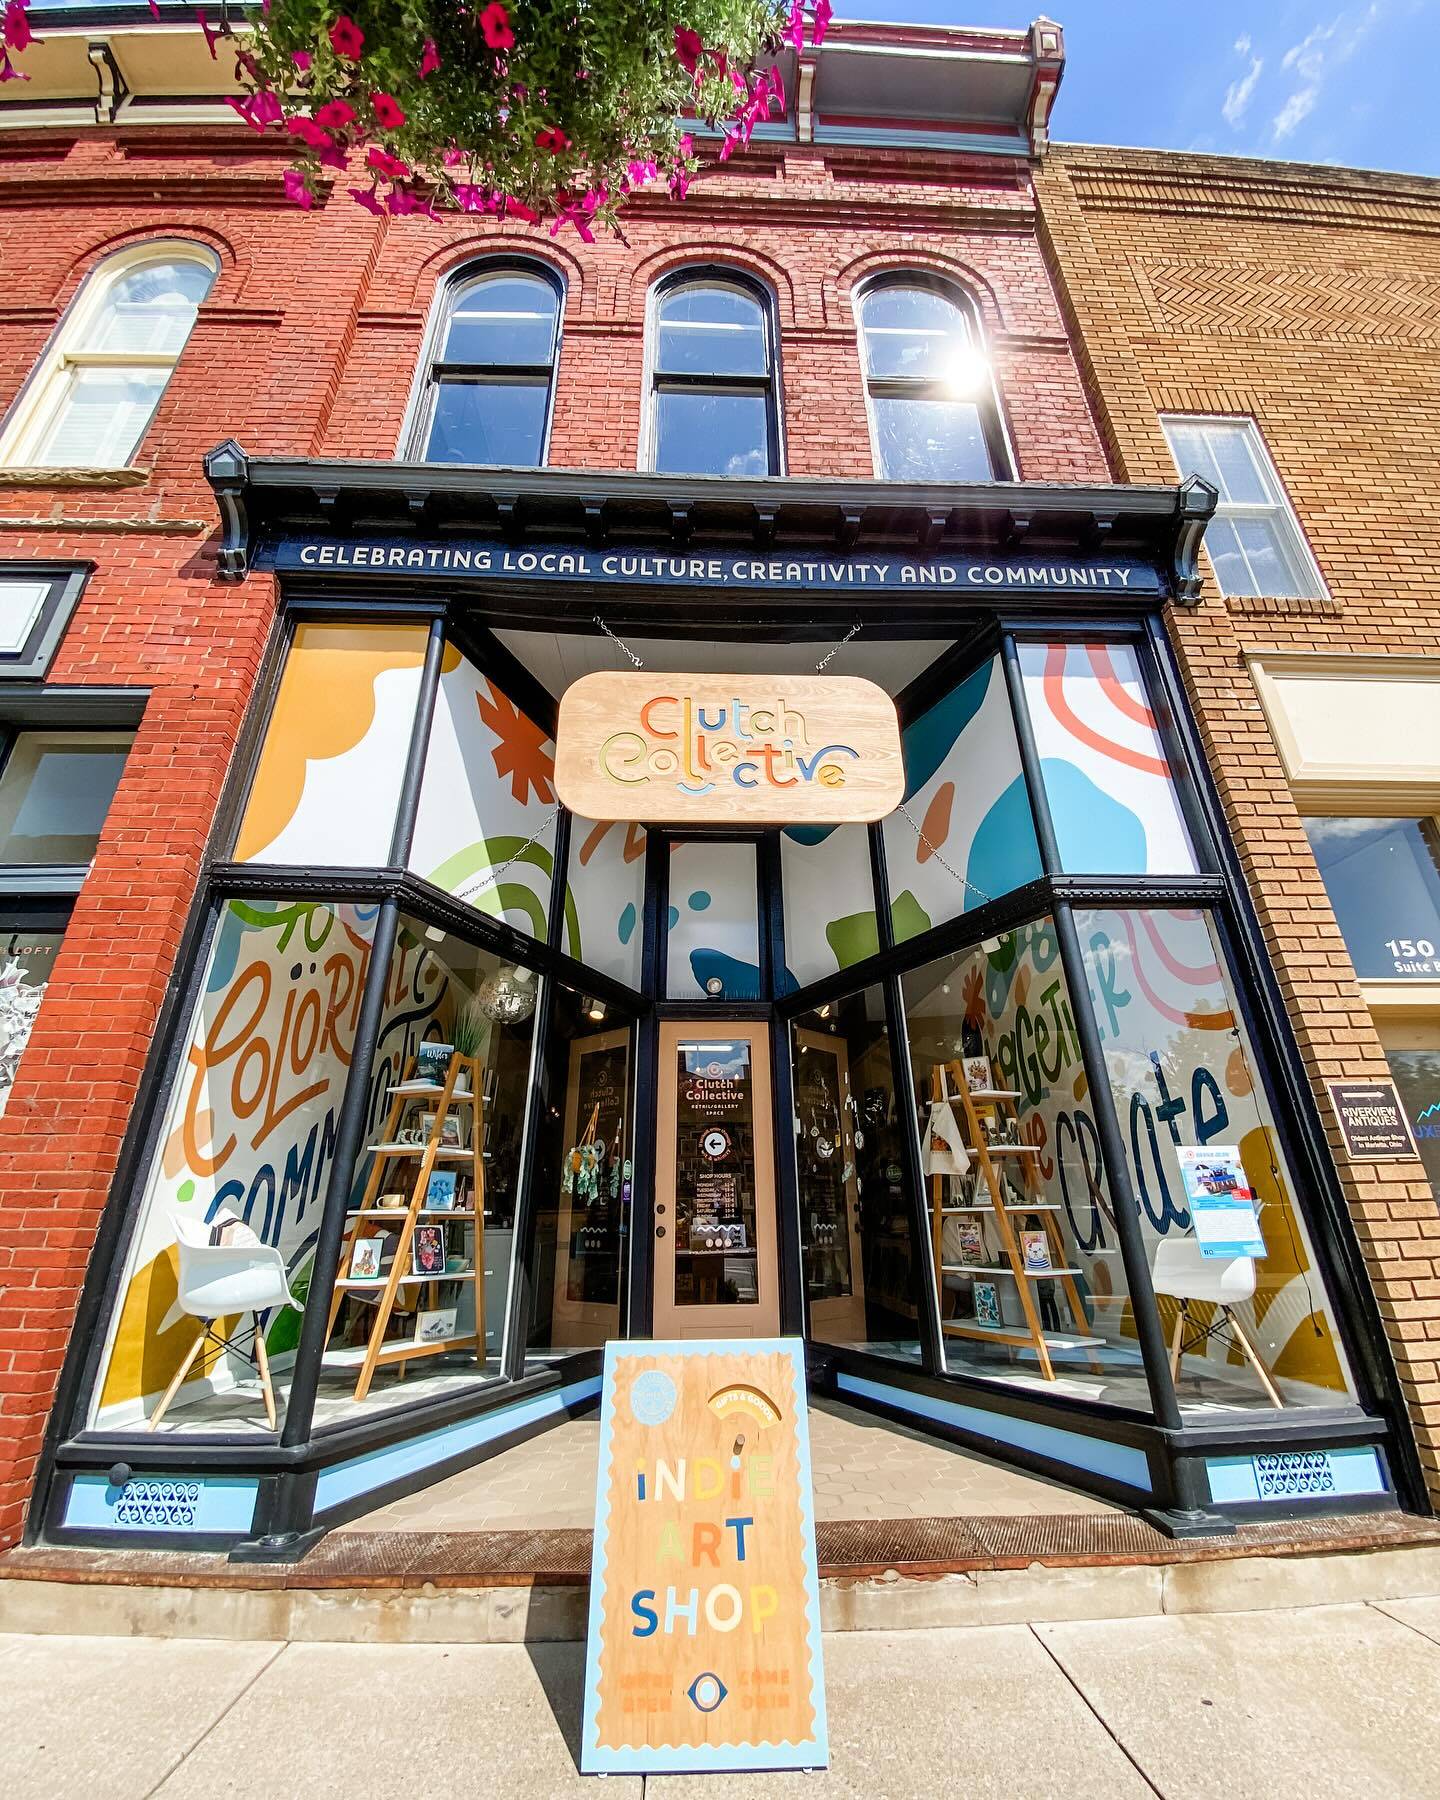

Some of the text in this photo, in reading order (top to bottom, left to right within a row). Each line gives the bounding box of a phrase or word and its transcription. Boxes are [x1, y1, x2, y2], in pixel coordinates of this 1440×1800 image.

[300, 546, 491, 570] CELEBRATING
[503, 553, 591, 575] LOCAL
[901, 565, 957, 585] AND
[967, 567, 1132, 587] COMMUNITY
[641, 696, 811, 748] Clutch
[599, 732, 859, 789] Collective
[14, 946, 52, 955] LOFT
[1384, 939, 1436, 958] 150
[1393, 960, 1431, 973] Suite
[696, 1079, 734, 1089] Clutch
[685, 1090, 744, 1100] Collective
[1341, 1106, 1396, 1118] RIVERVIEW
[1348, 1116, 1399, 1127] ANTIQUES
[1369, 1134, 1391, 1142] Antique
[1391, 1133, 1406, 1142] Shop
[739, 1392, 746, 1401] &
[656, 1516, 754, 1569] ART
[631, 1583, 780, 1639] SHOP
